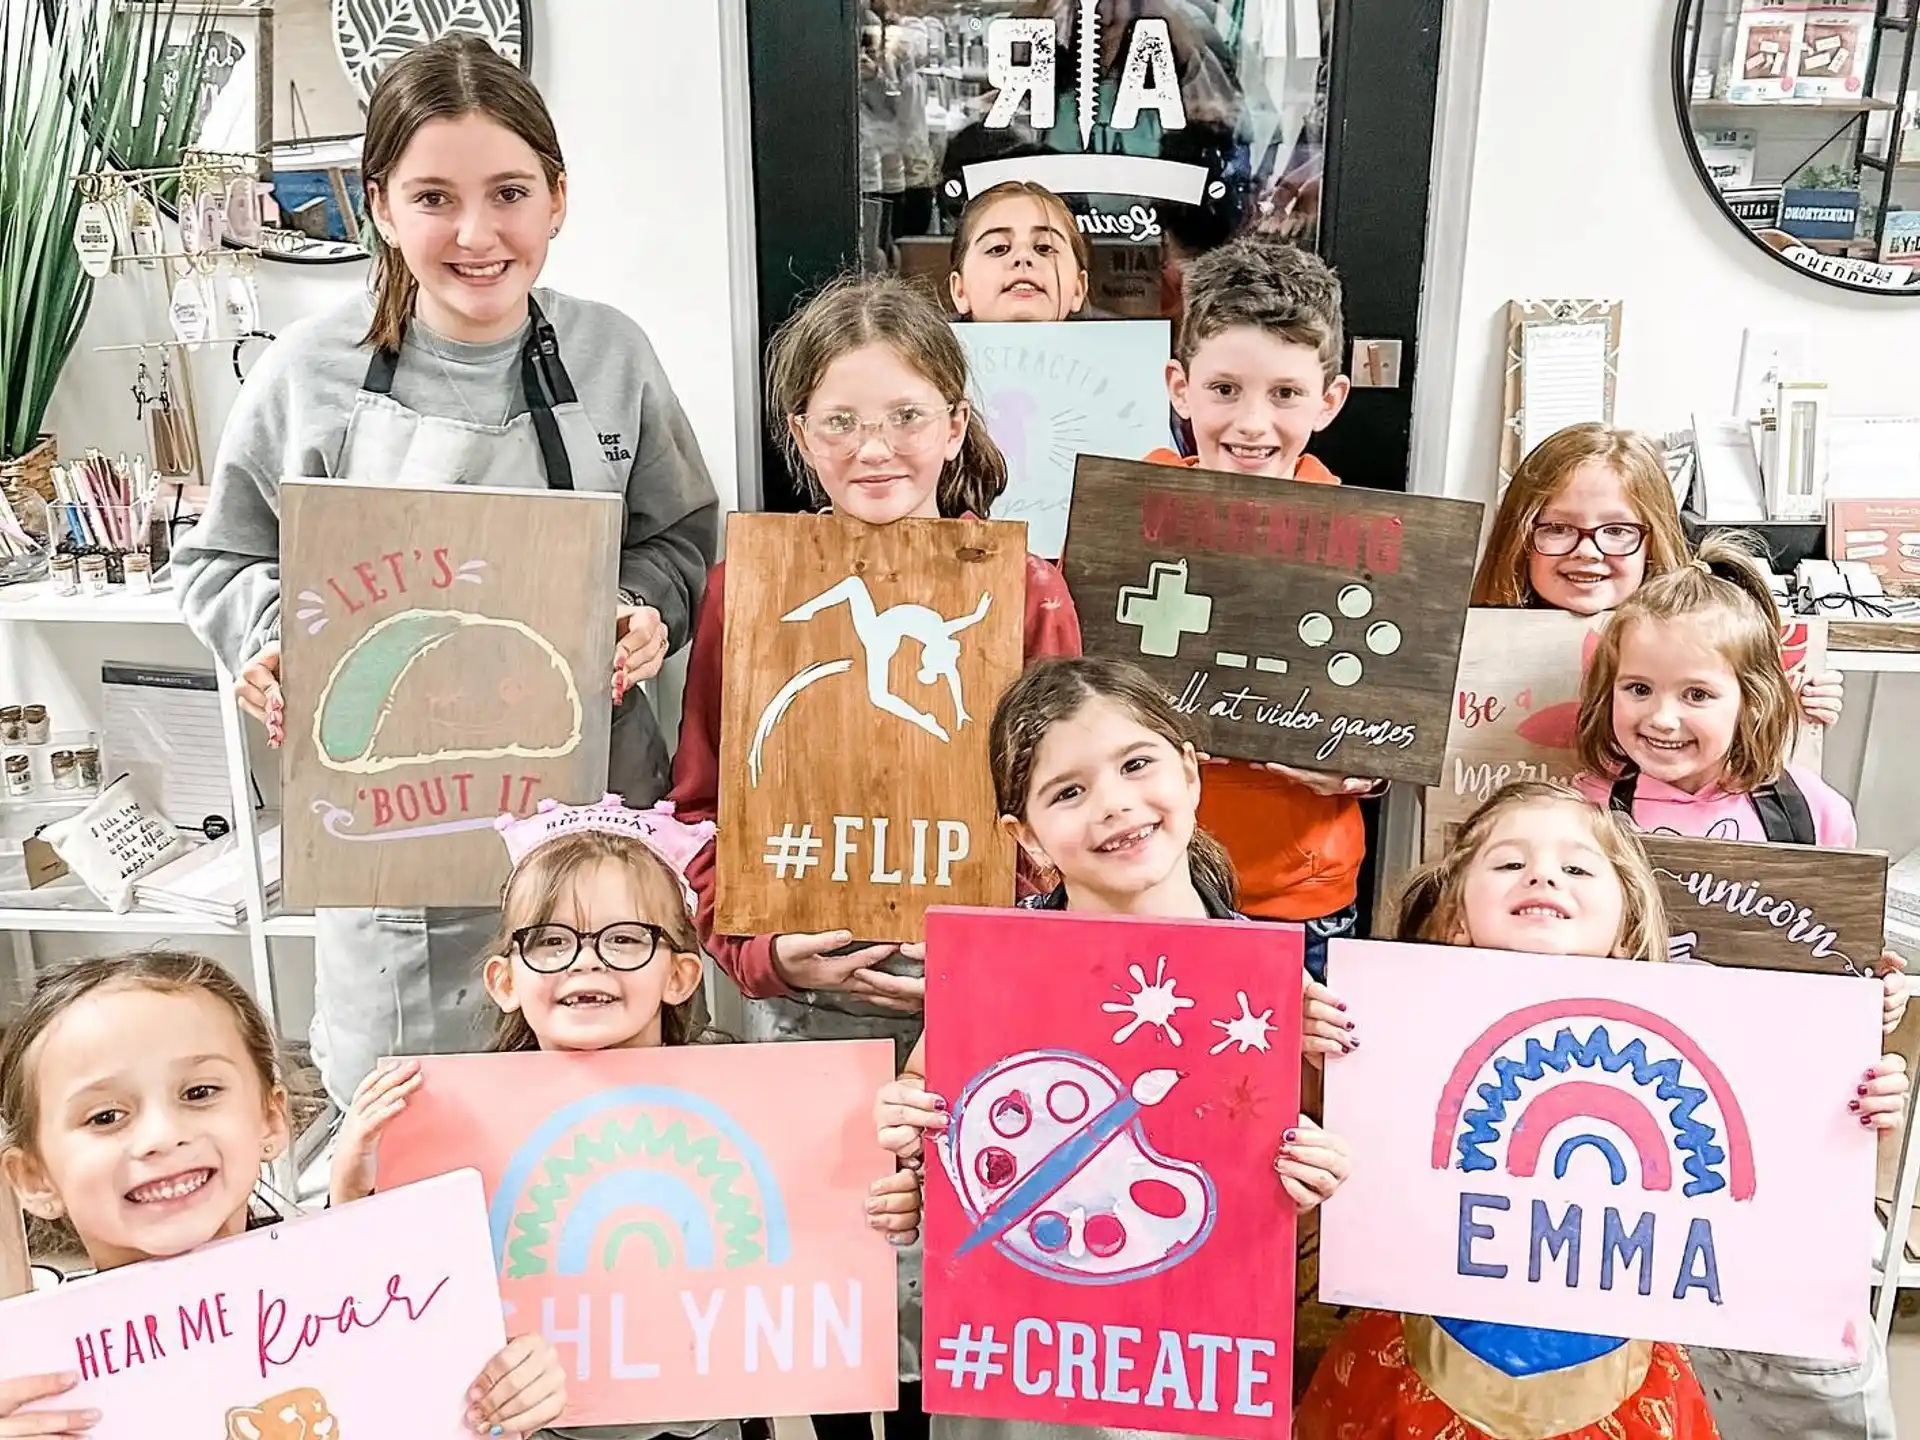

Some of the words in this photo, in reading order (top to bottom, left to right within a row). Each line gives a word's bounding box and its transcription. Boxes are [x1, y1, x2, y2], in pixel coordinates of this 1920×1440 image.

[597, 432, 621, 445] ter
[604, 446, 632, 461] nia
[1141, 489, 1403, 574] WARNING
[327, 548, 453, 615] LET'S
[1209, 687, 1268, 720] at
[1256, 688, 1324, 730] video
[1316, 714, 1417, 761] games
[1458, 691, 1506, 728] Be
[358, 773, 474, 827] 'BOUT
[498, 774, 541, 814] IT
[763, 816, 970, 886] #FLIP
[1672, 870, 1850, 965] unicorn
[1457, 1191, 1724, 1305] EMMA
[75, 1312, 165, 1381] HEAR
[179, 1293, 233, 1350] ME
[257, 1274, 450, 1378] Roar
[500, 1278, 862, 1381] HLYNN
[935, 1317, 1277, 1418] #CREATE
